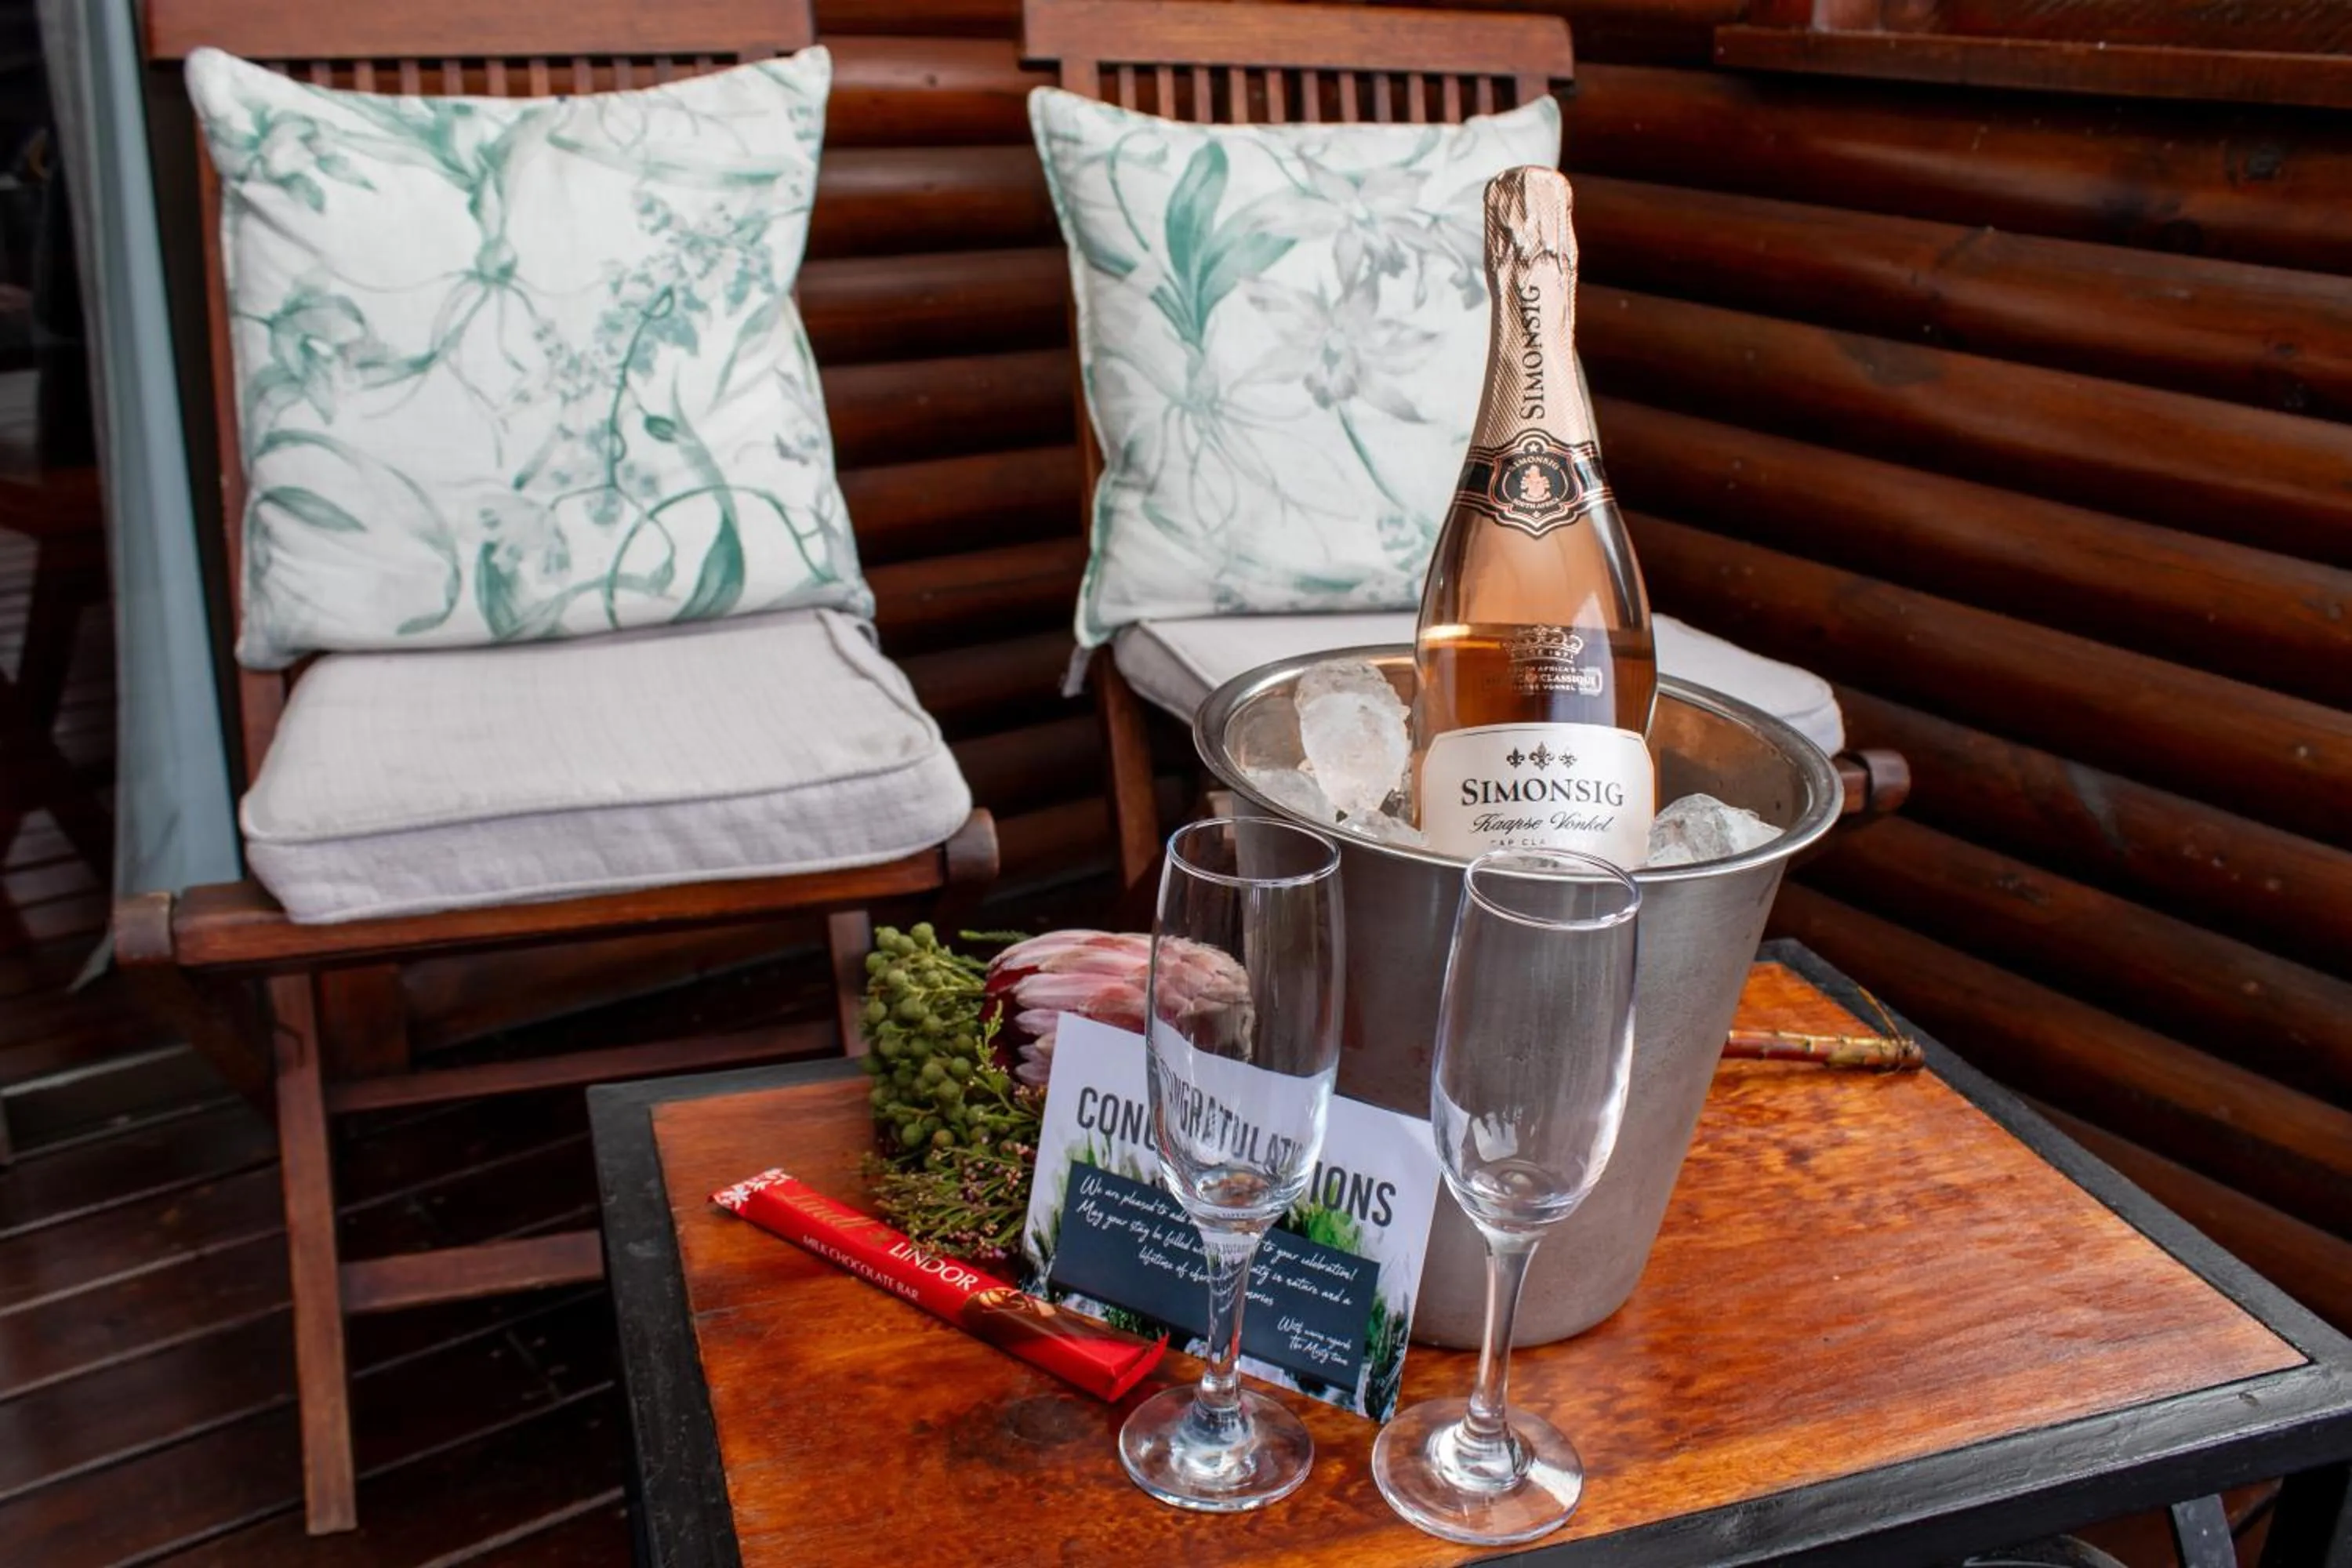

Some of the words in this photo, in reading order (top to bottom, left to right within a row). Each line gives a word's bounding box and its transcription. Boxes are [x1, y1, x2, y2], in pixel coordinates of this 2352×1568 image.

[1519, 285, 1545, 420] SIMONSIG
[1461, 778, 1624, 807] SIMONSIG
[1469, 812, 1544, 835] Kaapse
[1549, 810, 1615, 833] Vonkel
[1080, 1174, 1102, 1196] We
[1076, 1199, 1104, 1226] May
[803, 1234, 827, 1254] MILK
[829, 1245, 895, 1288] CHOCOLATE
[896, 1281, 920, 1300] BAR
[889, 1241, 978, 1291] LINDOR
